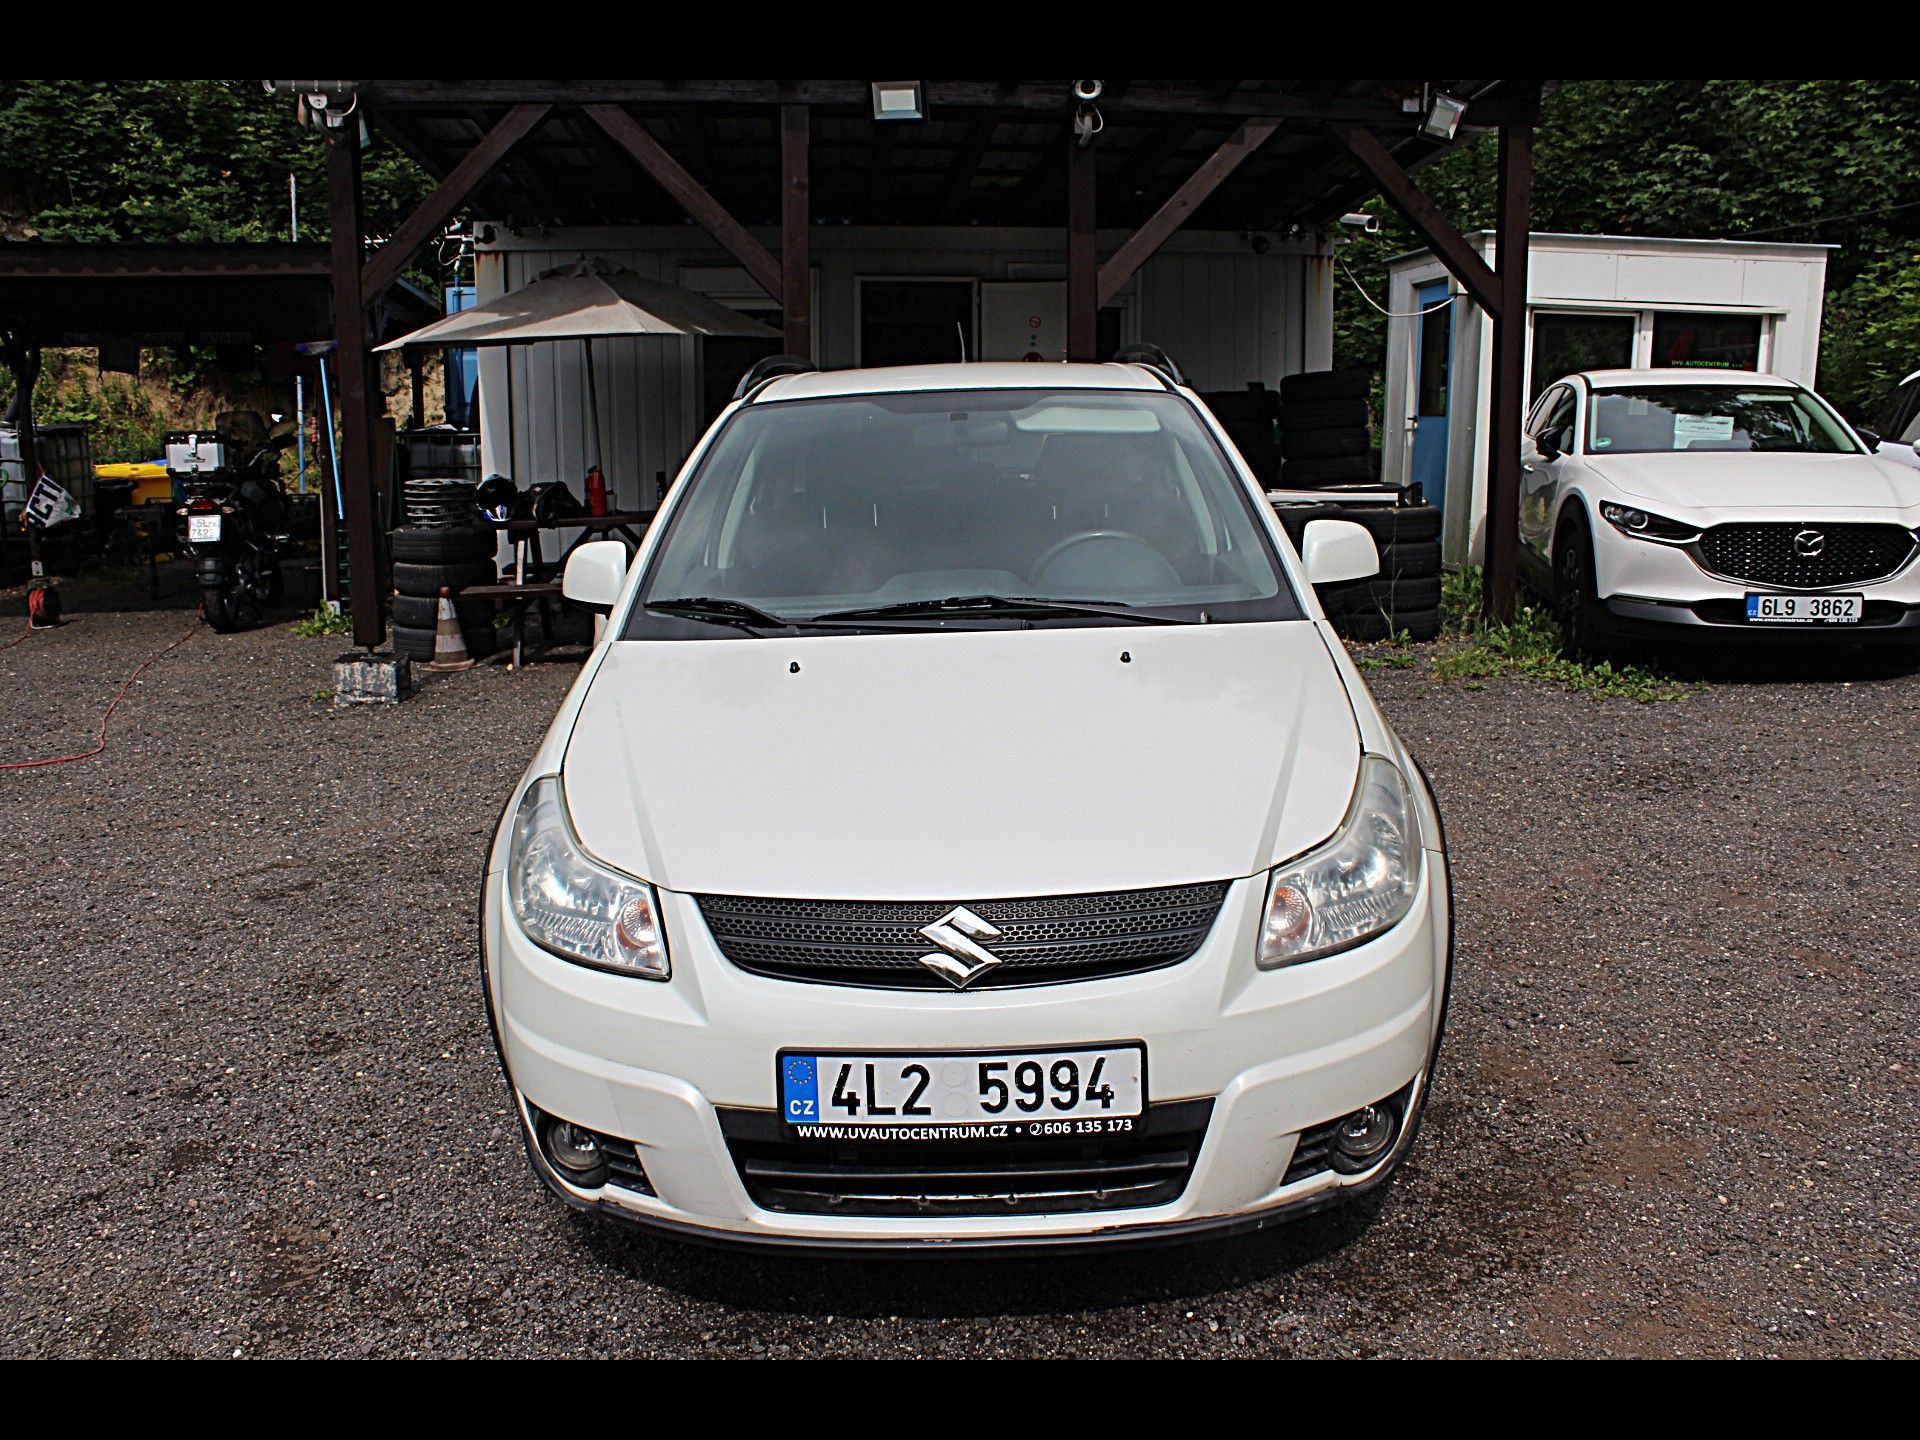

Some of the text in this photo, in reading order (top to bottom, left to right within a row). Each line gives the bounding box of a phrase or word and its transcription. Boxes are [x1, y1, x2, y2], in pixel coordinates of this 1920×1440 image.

[1761, 598, 1854, 617] 6L9 3862
[831, 1057, 1115, 1116] 4L2 5994
[789, 1100, 815, 1116] CZ
[797, 1119, 1133, 1140] WWW.UVAUTOCENTRUM.CZ 606 135 173
